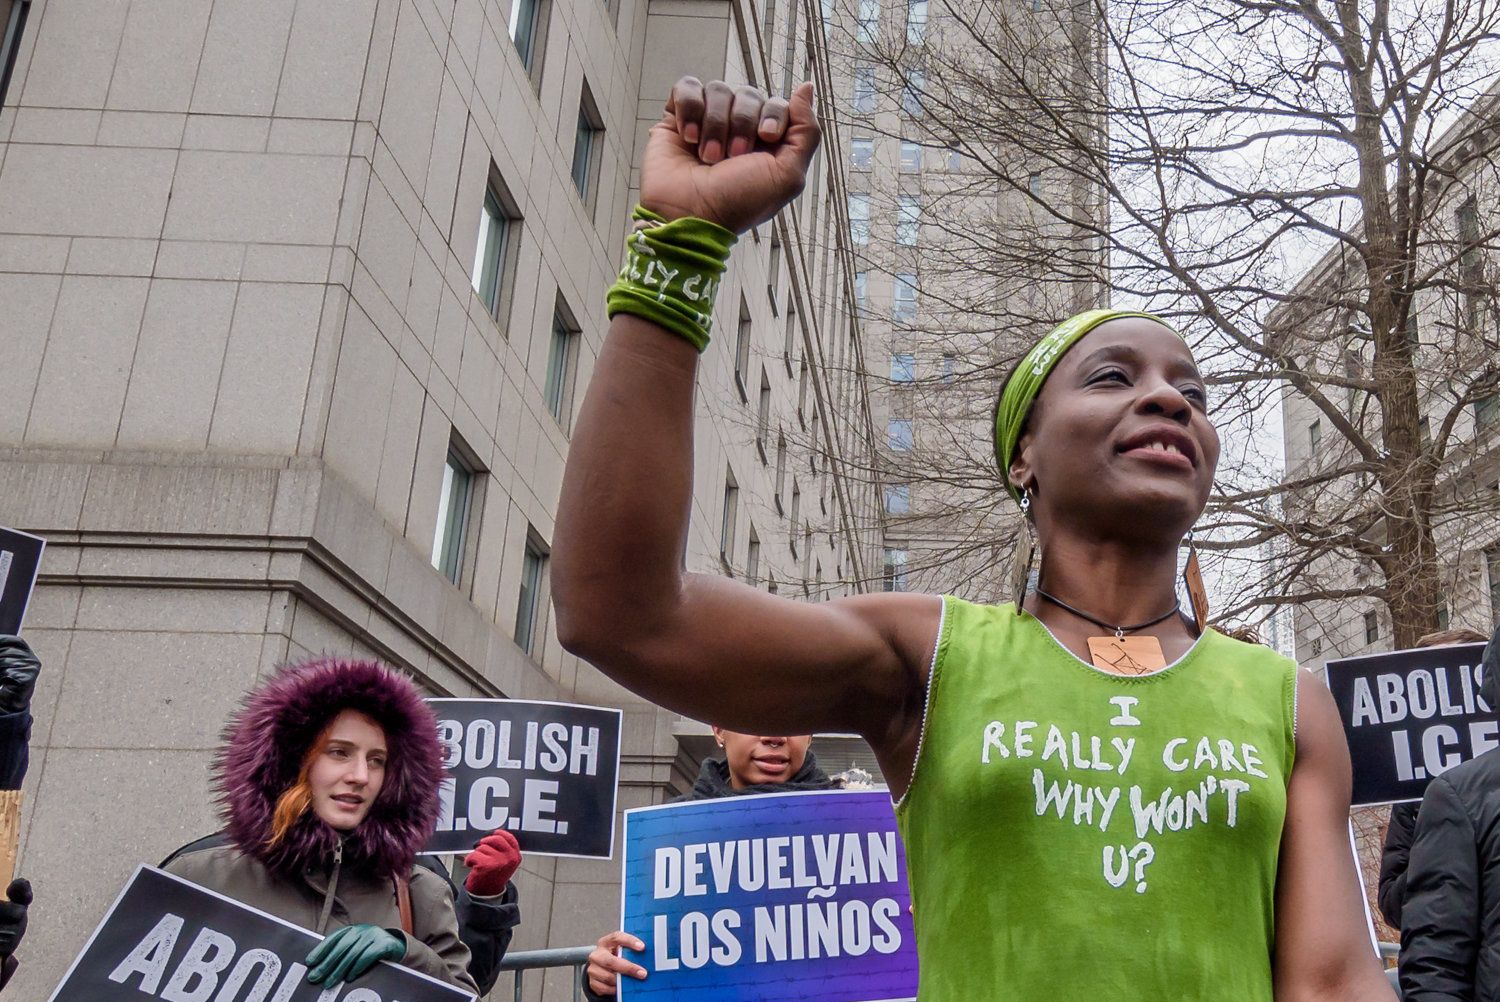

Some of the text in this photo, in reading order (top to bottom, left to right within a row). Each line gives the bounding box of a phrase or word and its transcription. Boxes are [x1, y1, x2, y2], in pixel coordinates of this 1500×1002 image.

[1109, 696, 1141, 726] I
[436, 719, 600, 776] BOLISH
[981, 720, 1268, 779] REALLY CARE
[1032, 768, 1250, 839] WHY WON'T
[654, 831, 899, 899] DEVUELVAN
[1102, 841, 1155, 893] U?
[654, 884, 902, 972] LOS NIÑOS
